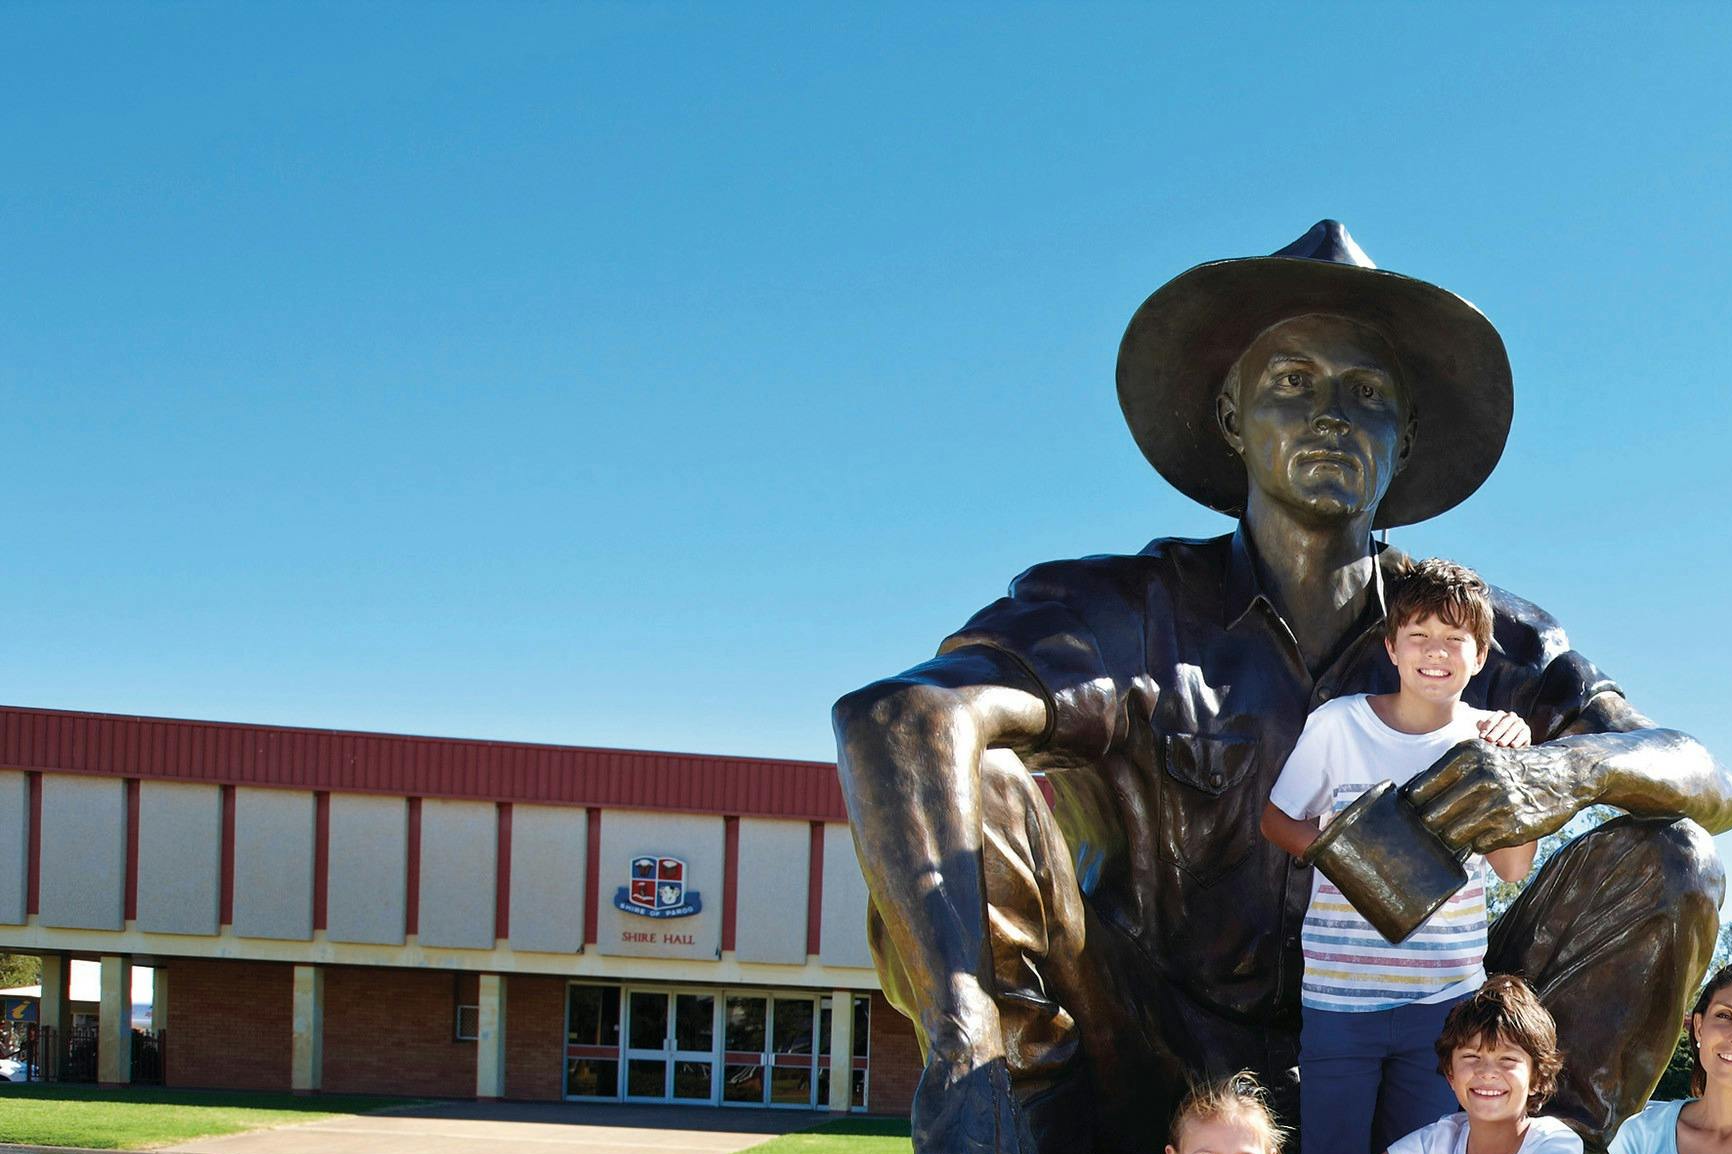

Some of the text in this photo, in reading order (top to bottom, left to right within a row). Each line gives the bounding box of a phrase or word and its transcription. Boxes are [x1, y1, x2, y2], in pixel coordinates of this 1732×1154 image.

[620, 903, 646, 915] SHIRE
[622, 931, 696, 945] SHIRE HALL
